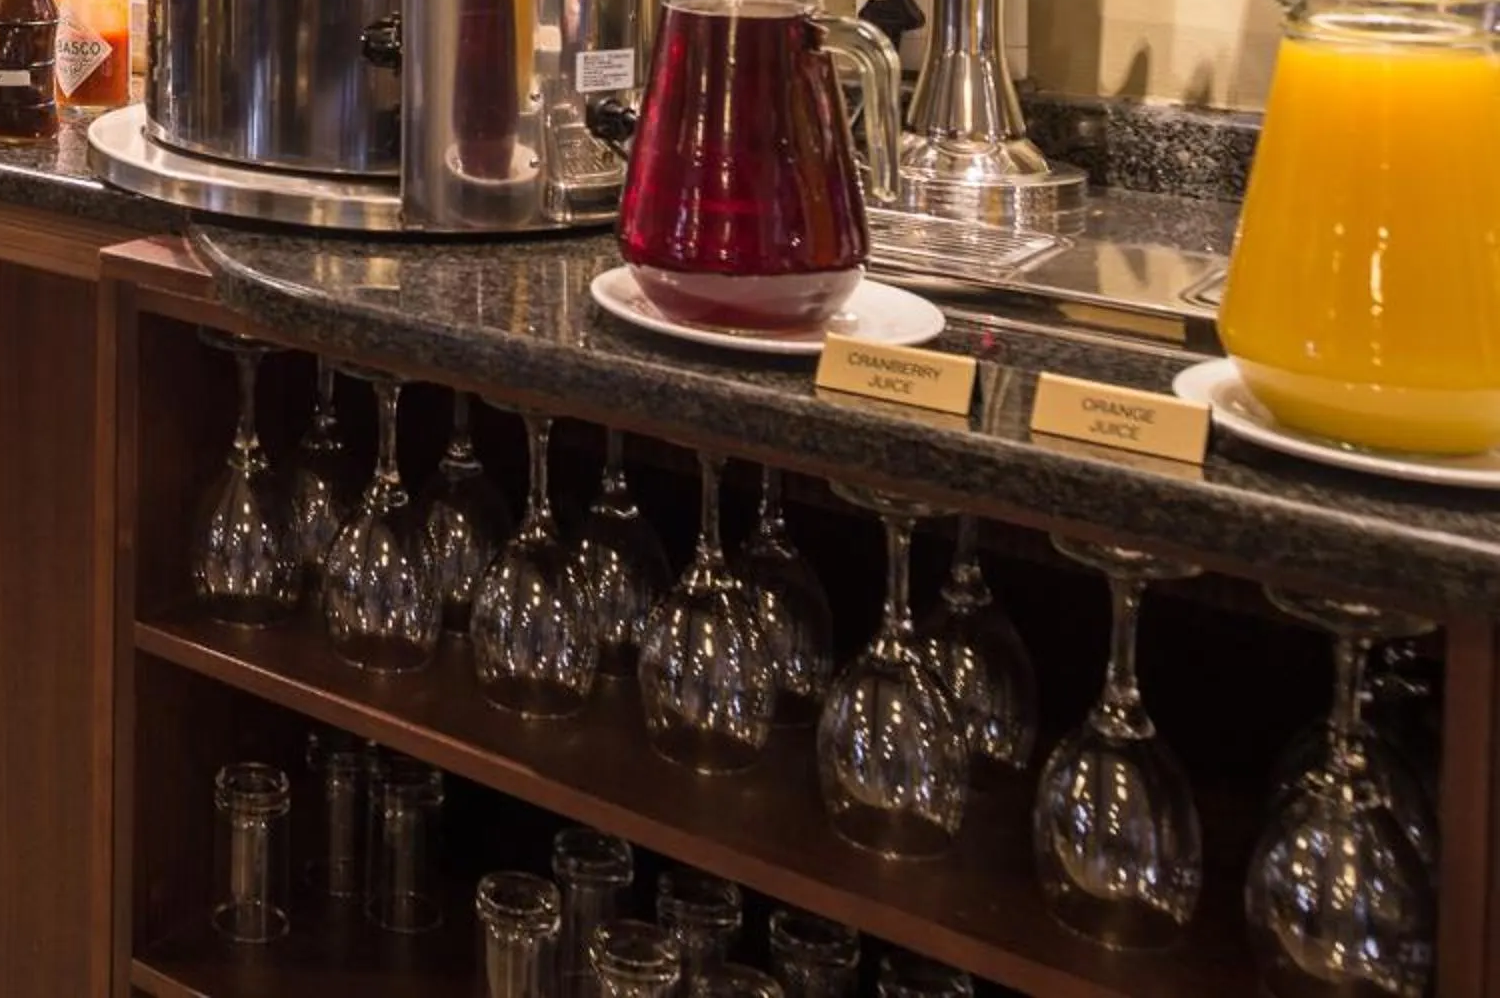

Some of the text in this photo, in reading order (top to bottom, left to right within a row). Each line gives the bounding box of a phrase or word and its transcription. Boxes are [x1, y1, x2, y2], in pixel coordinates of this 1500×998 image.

[57, 39, 101, 56] BASCO
[847, 351, 943, 381] CRANBERRY
[867, 373, 914, 395] JUICE
[1081, 397, 1156, 425] ORANGE
[1088, 419, 1140, 441] JUICE
